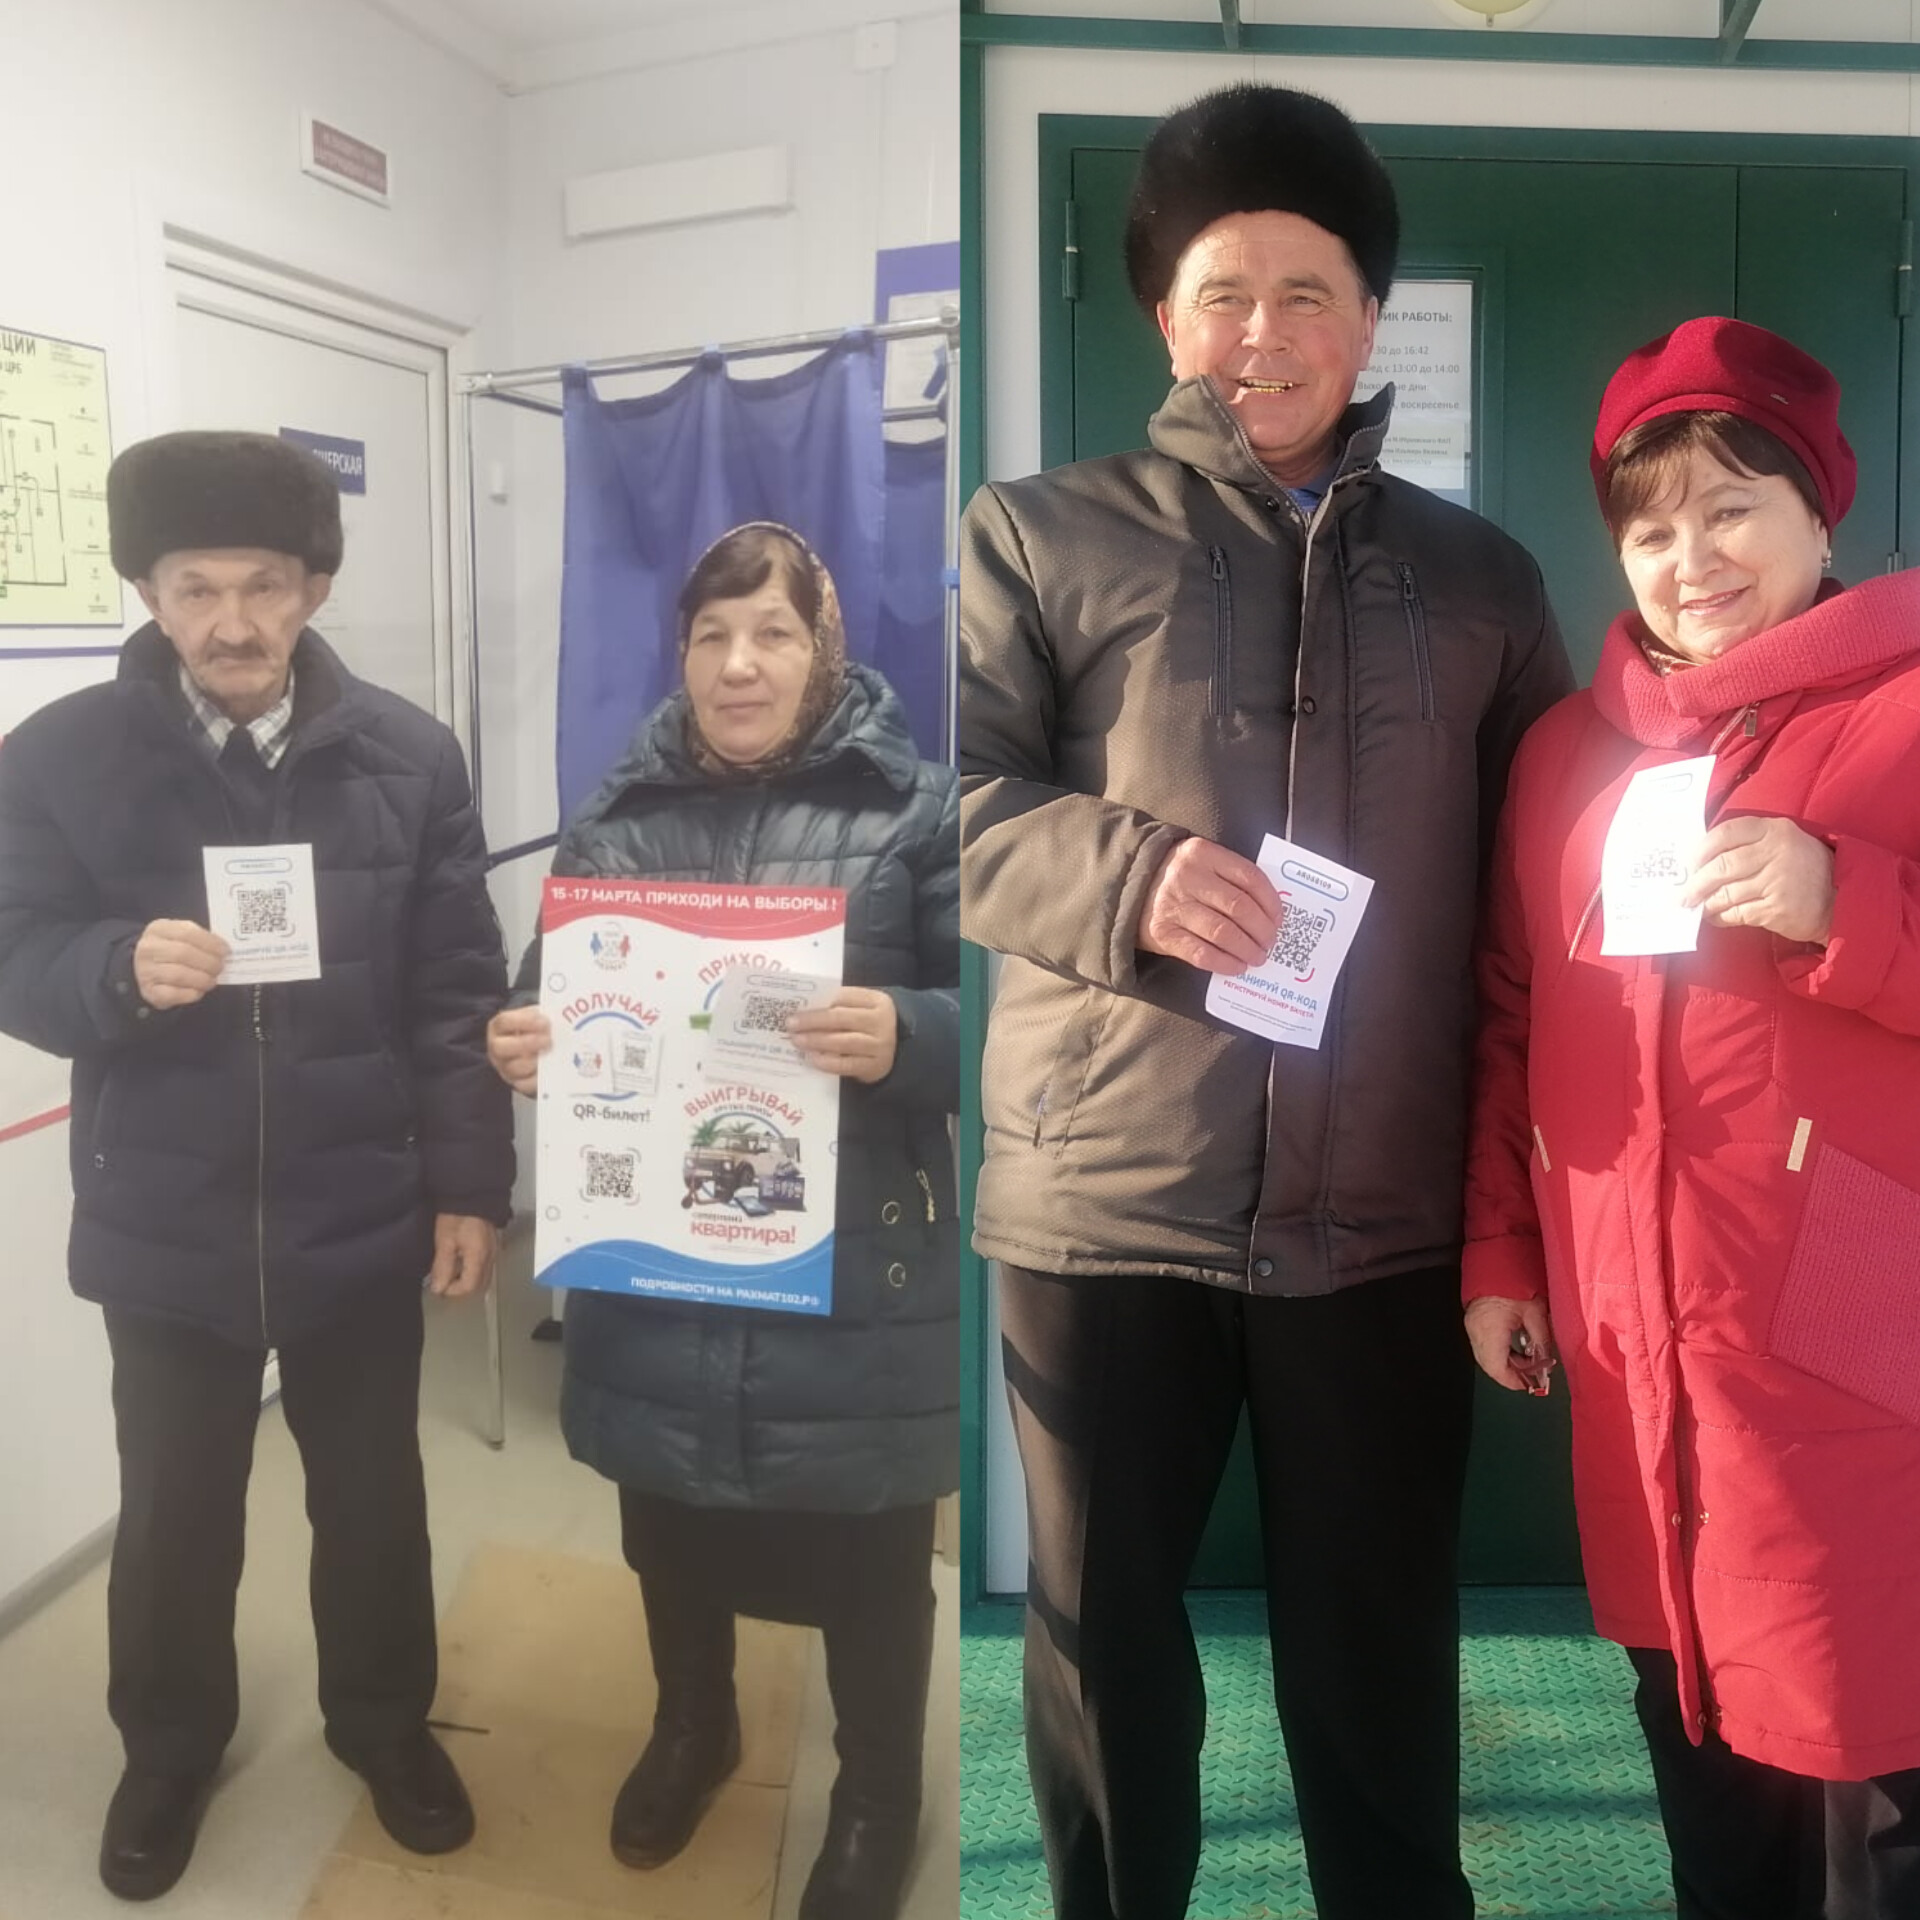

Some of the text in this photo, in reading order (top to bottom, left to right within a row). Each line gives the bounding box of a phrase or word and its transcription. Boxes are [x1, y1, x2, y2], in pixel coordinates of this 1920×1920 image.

[1402, 312, 1453, 322] РАБОТЫ:
[0, 333, 36, 355] ЦИИ
[1389, 347, 1401, 356] до
[1404, 346, 1429, 355] 16:42
[1393, 364, 1417, 373] 13:00
[1419, 366, 1431, 374] до
[1435, 364, 1460, 373] 14:00
[1400, 401, 1460, 411] воскресенье
[591, 888, 642, 903] МАРТА
[646, 891, 723, 909] ПРИХОДИ
[726, 894, 750, 908] НА
[698, 953, 790, 984] ПРИХОД
[1233, 972, 1318, 1010] АНИРУЙ QR-КОД
[561, 993, 660, 1026] ПОЛУЧАЙ
[573, 1103, 651, 1122] QR-билет!
[683, 1086, 804, 1126] ВЫИГРЫВАЙ
[691, 1221, 796, 1245] квартира!
[630, 1276, 715, 1295] ПОДРОБНОСТИ
[716, 1286, 733, 1297] НА
